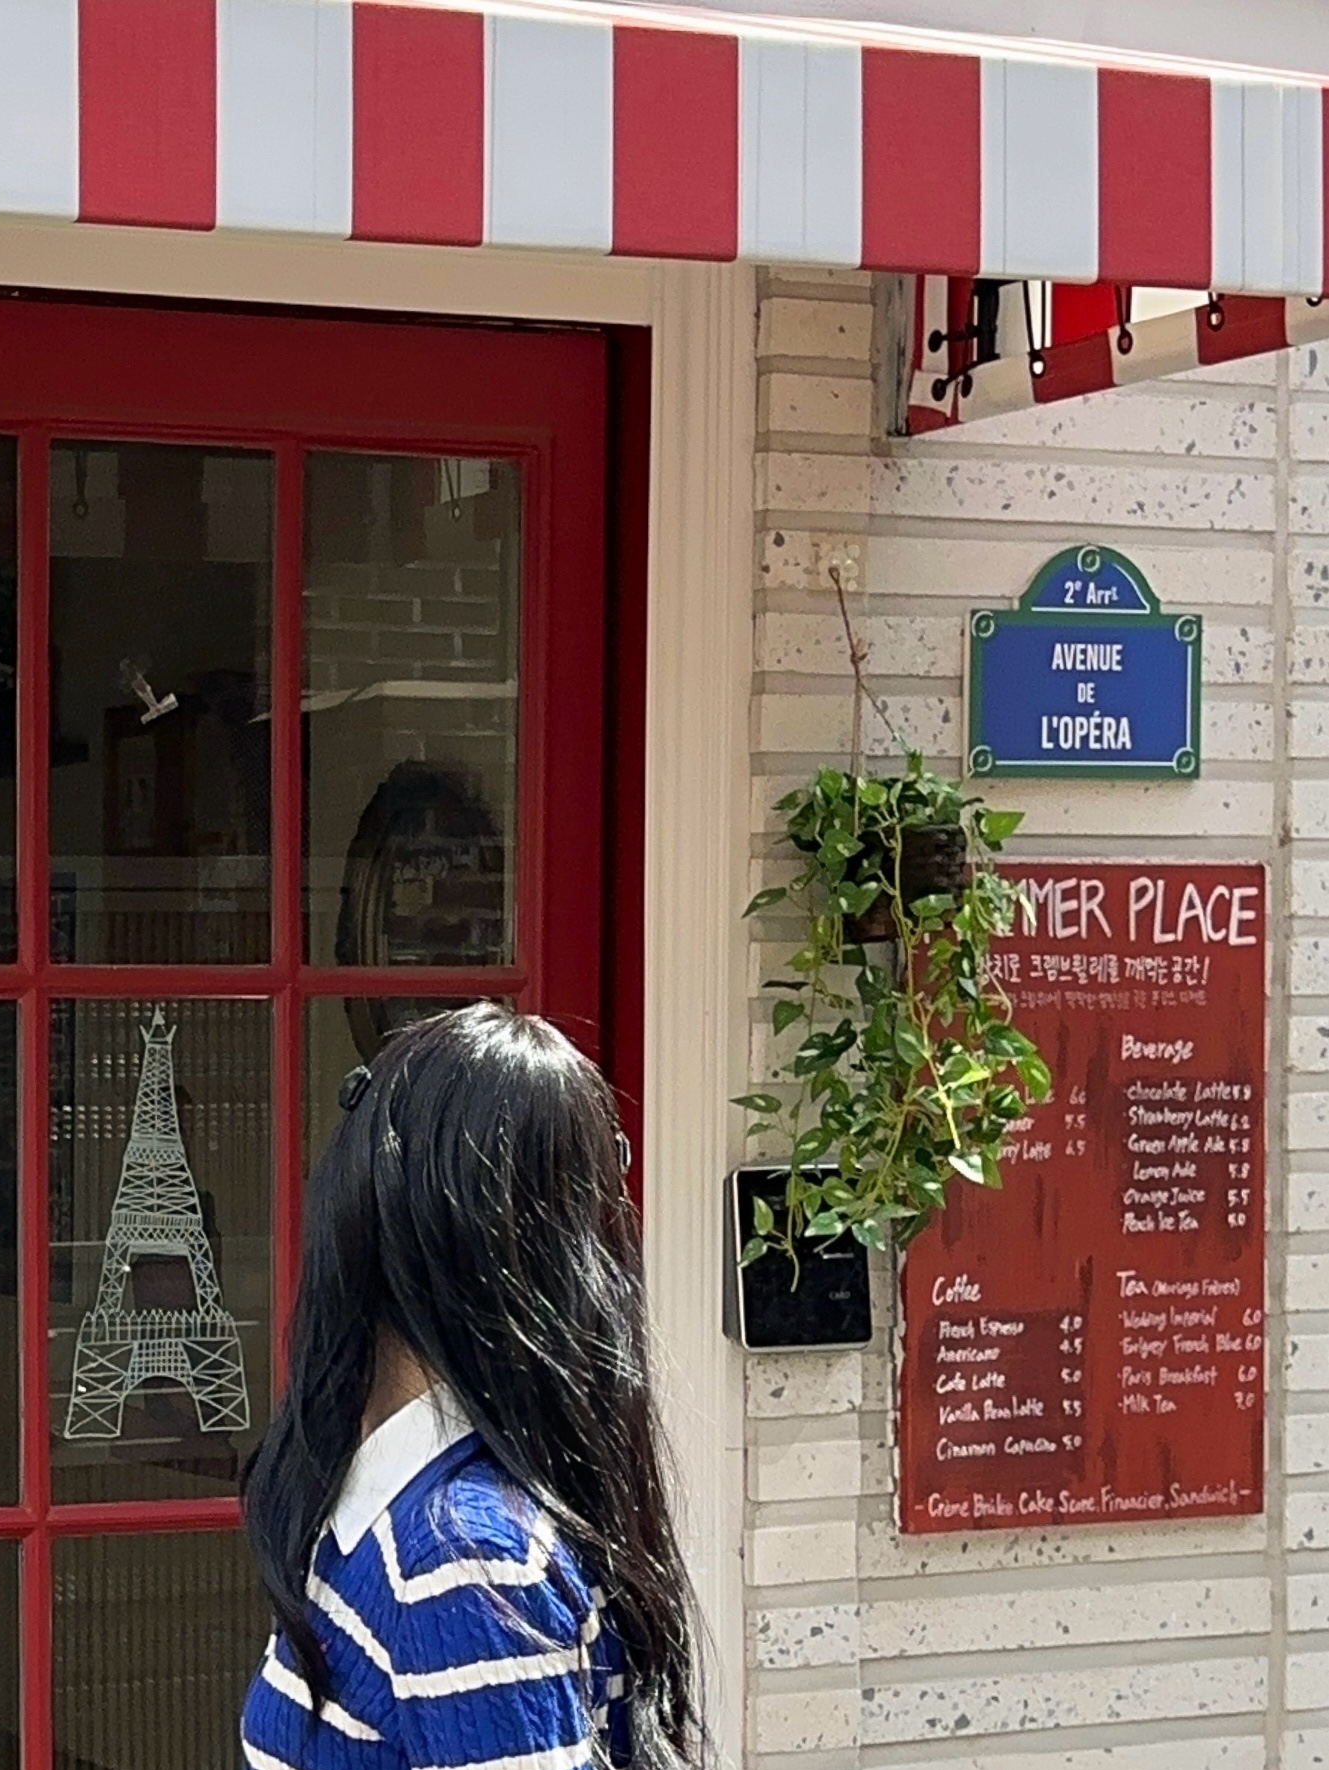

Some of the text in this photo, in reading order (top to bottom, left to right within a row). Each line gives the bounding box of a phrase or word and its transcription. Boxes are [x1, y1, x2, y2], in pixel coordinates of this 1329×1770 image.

[1051, 643, 1122, 671] AVENUE
[1077, 683, 1095, 703] DE
[1041, 710, 1132, 750] L'OPÉRA
[1129, 876, 1259, 946] PLACE
[1121, 1034, 1194, 1065] Beverage
[1195, 1109, 1229, 1128] Latte
[1133, 1160, 1170, 1181] Lemon
[1123, 1187, 1169, 1208] Orange
[1178, 1209, 1199, 1232] Tea
[932, 1273, 982, 1306] Coffee
[1116, 1270, 1149, 1298] Tea
[936, 1345, 1001, 1364] Americano
[972, 1371, 1006, 1391] Latte
[1122, 1365, 1152, 1388] Paris
[1158, 1364, 1218, 1386] Breakfast
[938, 1402, 980, 1426] Vanilla
[1012, 1395, 1045, 1418] Latte
[1122, 1393, 1150, 1415] Milk
[1153, 1394, 1177, 1415] Tea
